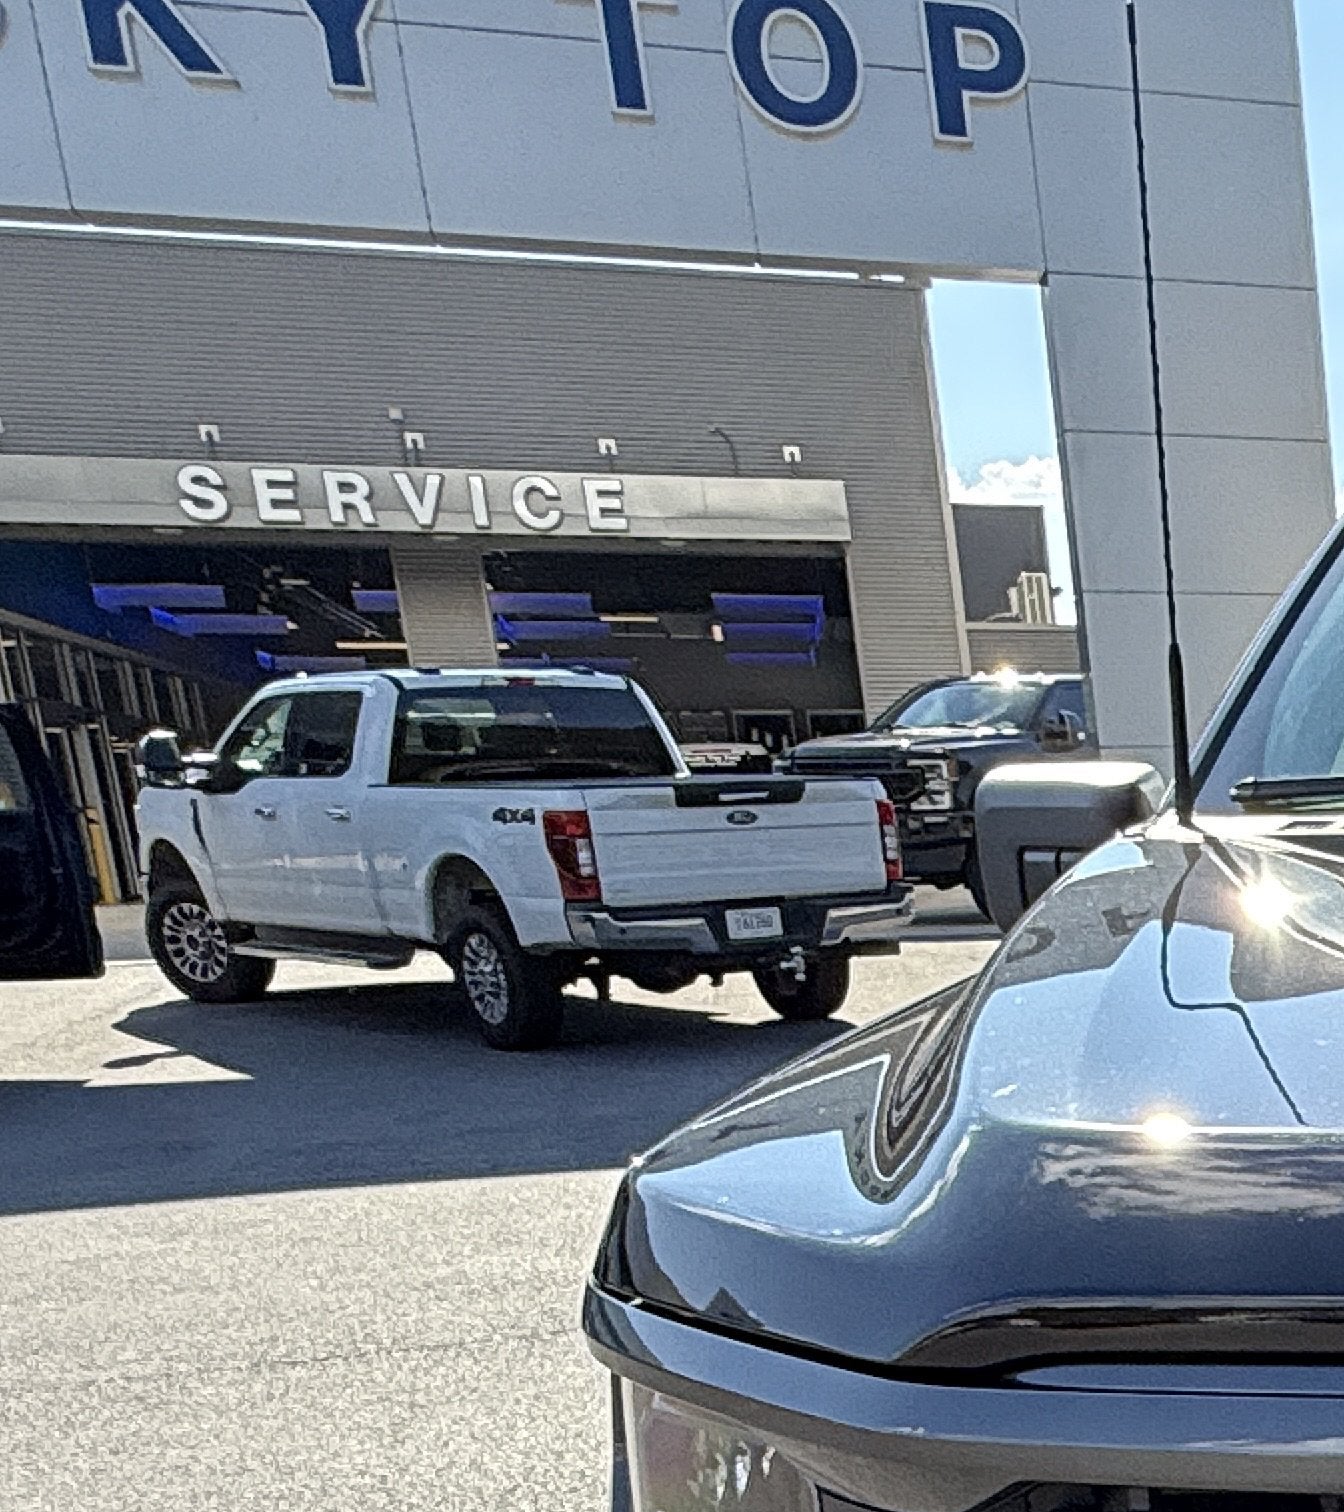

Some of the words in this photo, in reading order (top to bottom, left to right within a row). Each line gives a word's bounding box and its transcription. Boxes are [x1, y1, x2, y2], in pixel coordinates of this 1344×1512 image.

[0, 0, 374, 90] KY
[560, 0, 1030, 142] TOP
[177, 464, 630, 532] SERVICE
